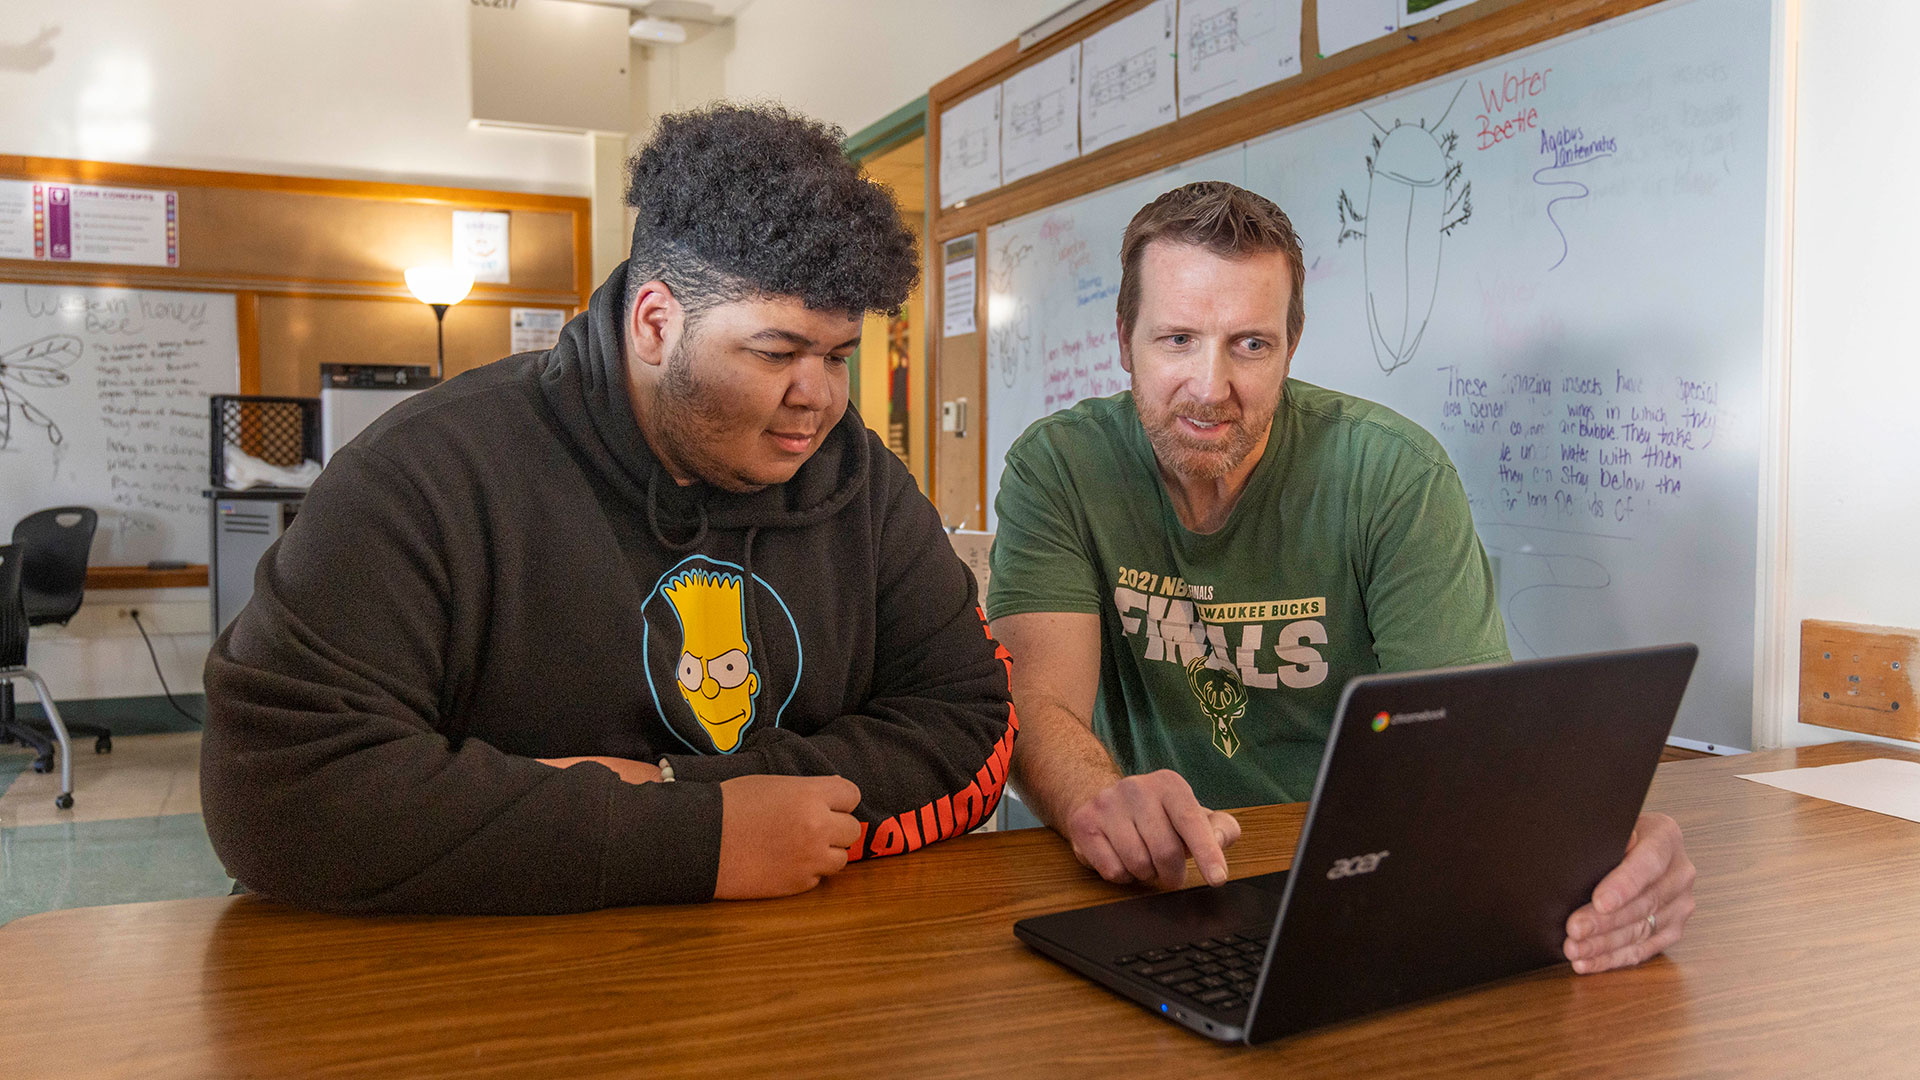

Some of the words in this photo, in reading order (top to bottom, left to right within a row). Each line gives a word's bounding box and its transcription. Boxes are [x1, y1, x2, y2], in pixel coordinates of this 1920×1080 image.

[1479, 67, 1552, 113] Water
[1475, 107, 1539, 151] Beetle
[1540, 126, 1585, 168] Agabus
[1437, 365, 1487, 397] These
[1562, 370, 1603, 396] insects
[1676, 376, 1718, 405] special
[1567, 403, 1594, 421] wings
[1606, 400, 1621, 420] in
[1631, 405, 1668, 425] which
[1621, 422, 1651, 445] They
[1658, 426, 1695, 451] take
[1599, 446, 1632, 466] with
[1641, 446, 1682, 470] them
[1499, 463, 1524, 494] they
[1655, 476, 1682, 498] the
[1118, 566, 1159, 593] 2021
[1159, 576, 1191, 598] NB
[1271, 601, 1320, 616] BUCKS
[1390, 707, 1447, 725] chromebook
[1326, 850, 1390, 880] acer
